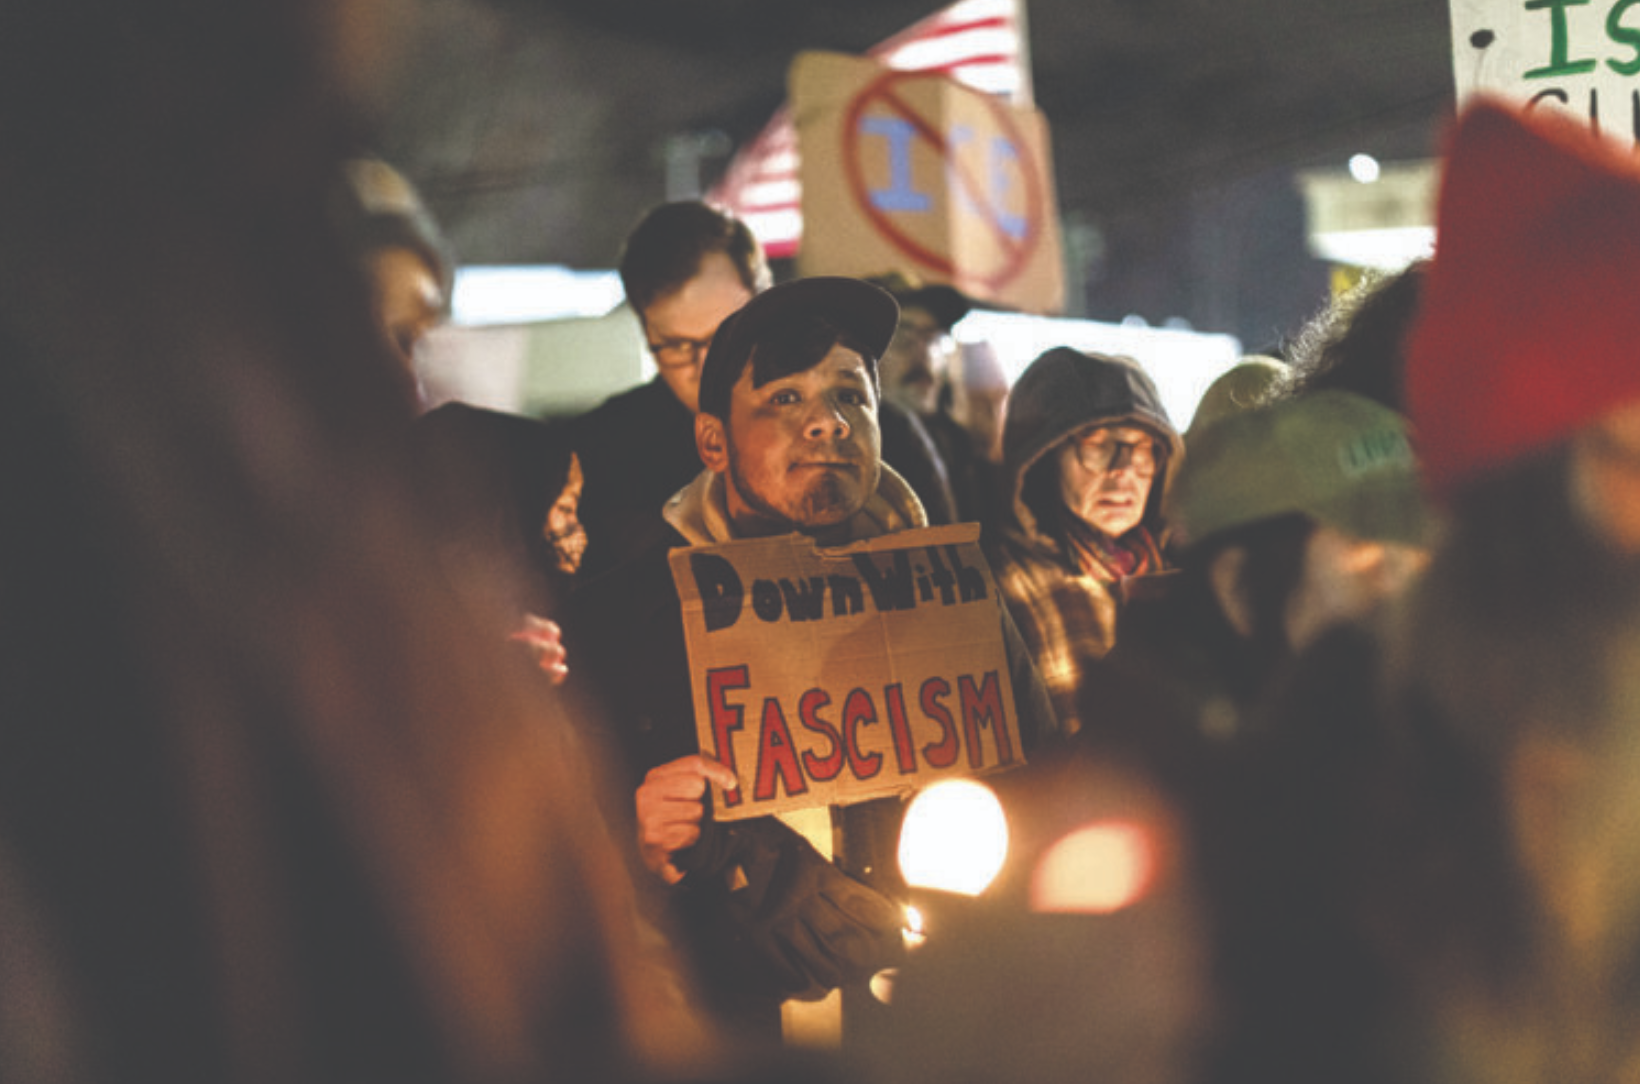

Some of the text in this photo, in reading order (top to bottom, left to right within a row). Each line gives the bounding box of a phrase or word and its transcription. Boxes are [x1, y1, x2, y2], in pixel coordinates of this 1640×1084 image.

[690, 545, 988, 632] Down With
[706, 664, 1014, 808] FASCISM
